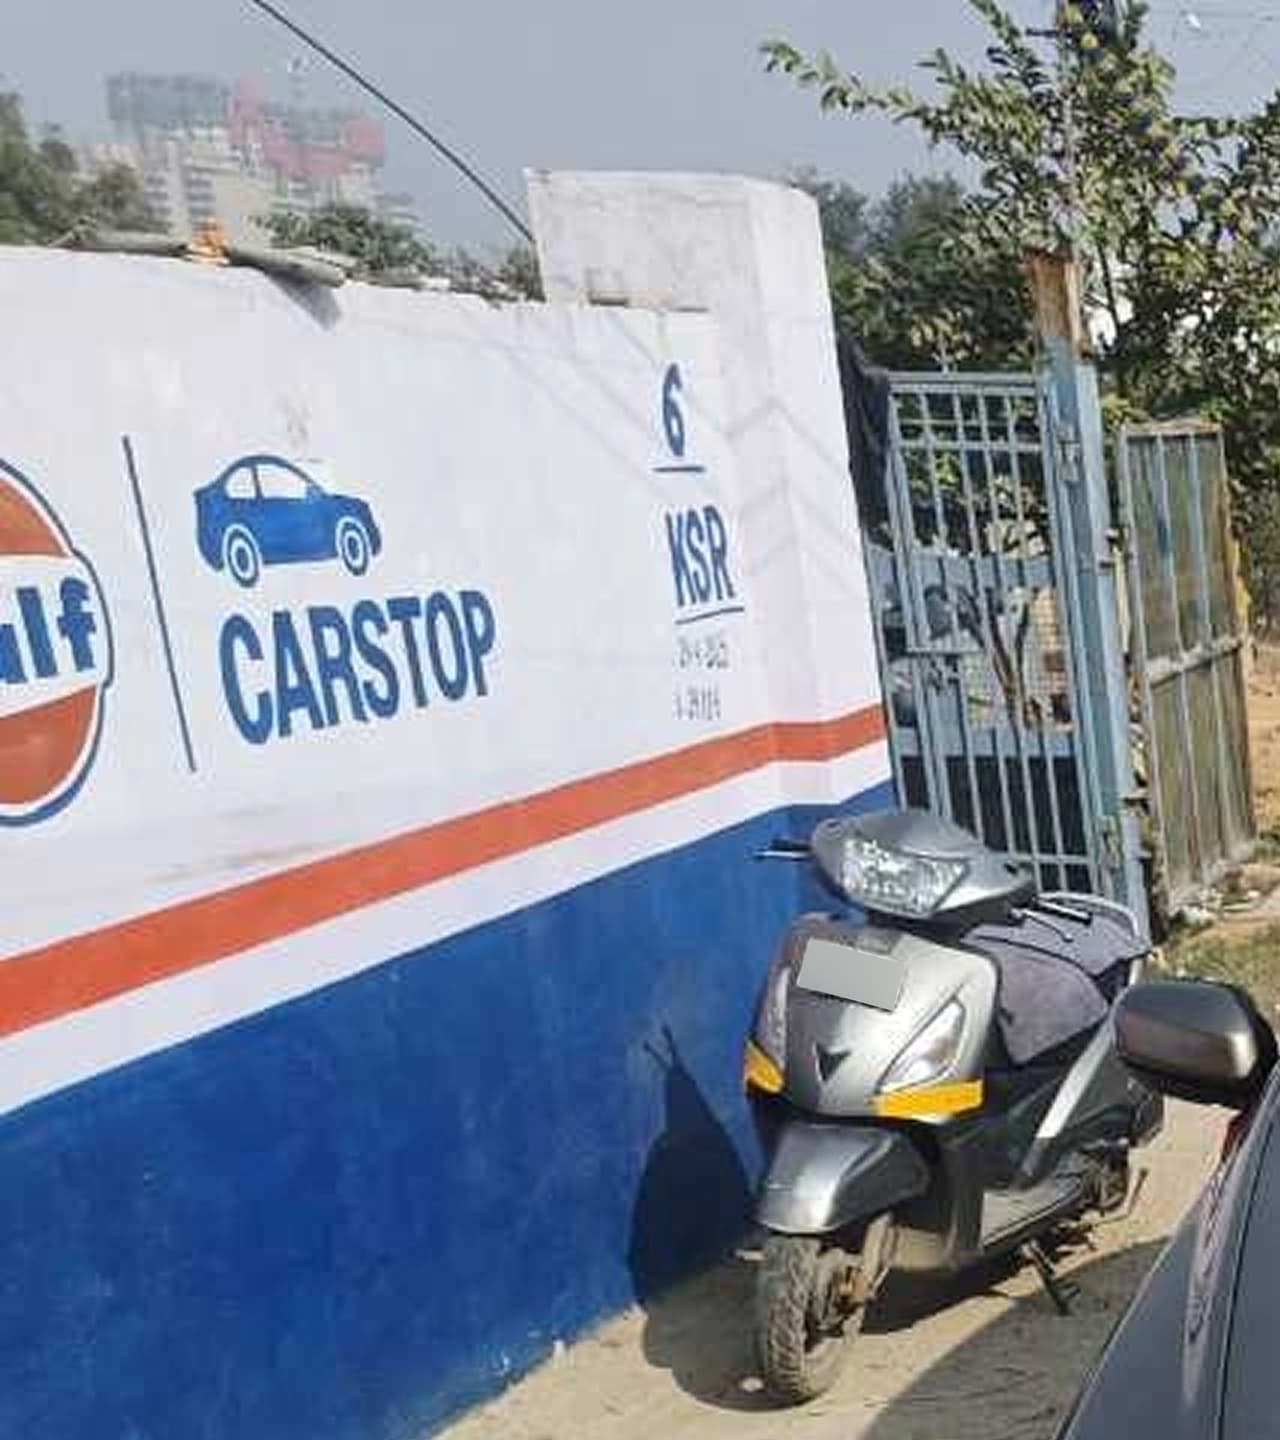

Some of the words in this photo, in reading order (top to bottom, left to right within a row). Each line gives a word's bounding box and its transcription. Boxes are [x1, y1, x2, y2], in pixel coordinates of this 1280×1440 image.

[662, 362, 685, 456] 6
[665, 504, 735, 606] KSR
[219, 590, 495, 744] CARSTOP
